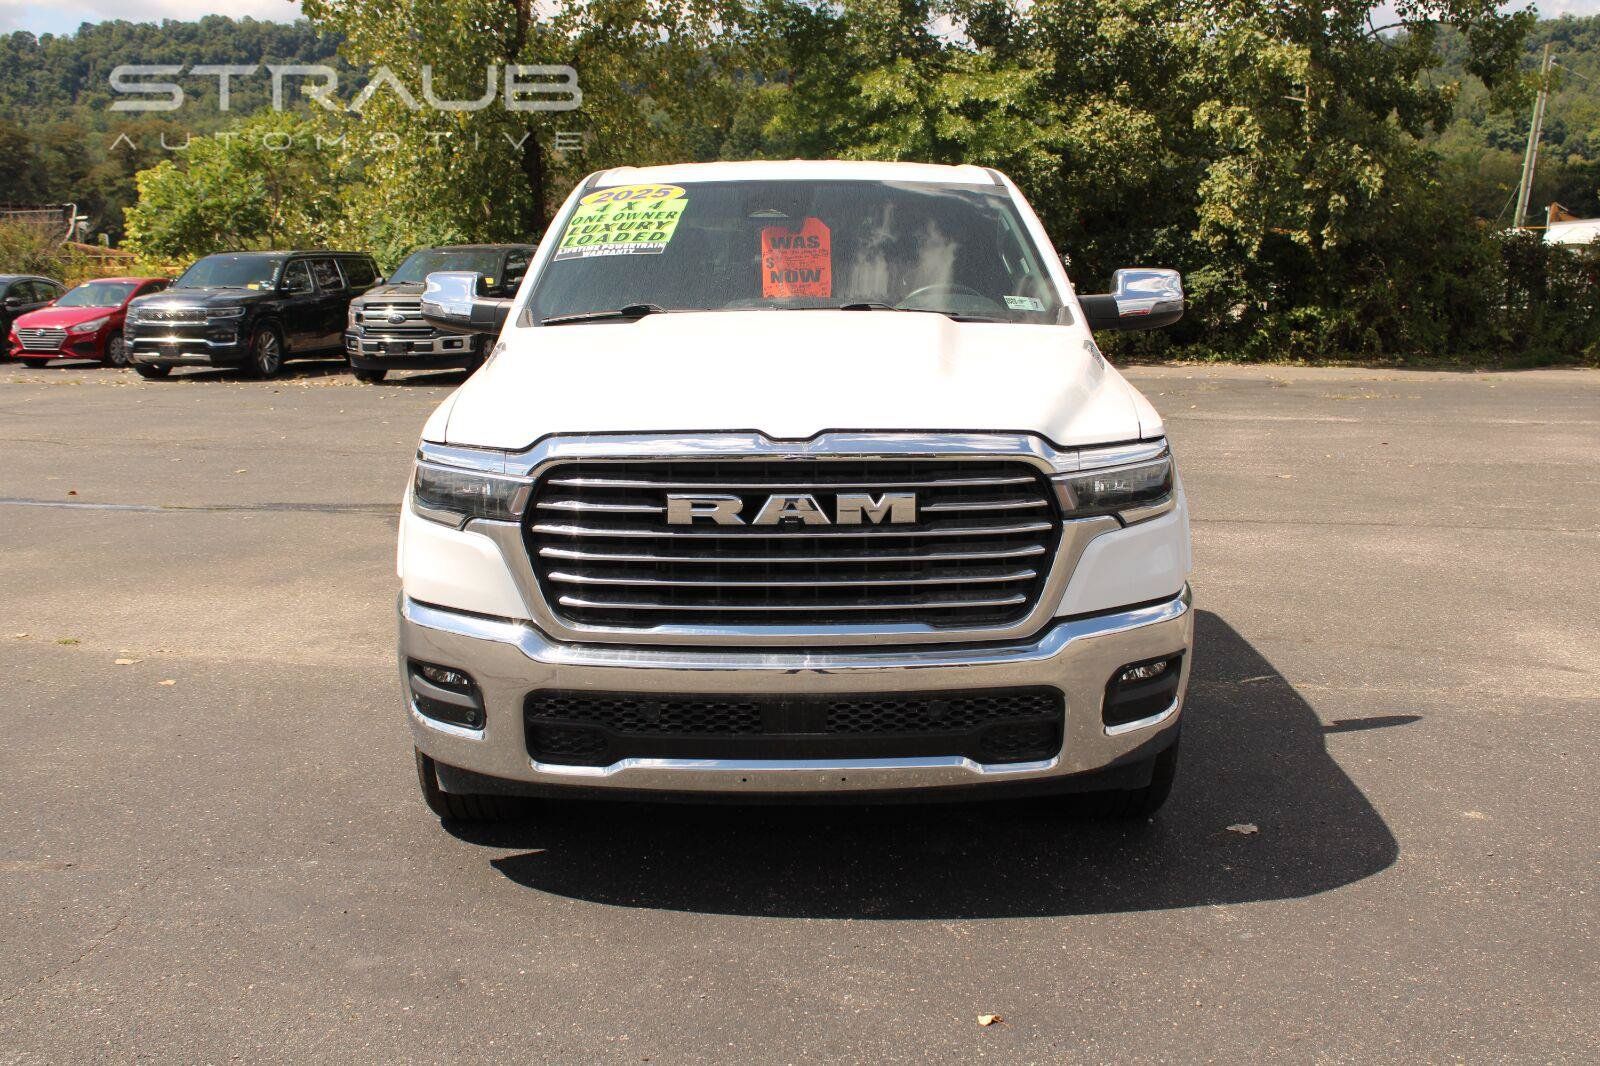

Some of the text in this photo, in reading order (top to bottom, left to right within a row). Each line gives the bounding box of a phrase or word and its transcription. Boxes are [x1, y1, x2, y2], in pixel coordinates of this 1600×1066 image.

[592, 188, 674, 204] 2025
[649, 200, 665, 210] 4
[571, 211, 678, 226] ONE OWNER
[568, 221, 672, 236] LUXURY
[563, 231, 666, 246] LOADED
[770, 235, 821, 249] WAS
[582, 247, 637, 257] WARRANTY
[601, 242, 666, 251] POWERTRAIN
[770, 269, 822, 284] NOW
[667, 493, 916, 525] RAM
